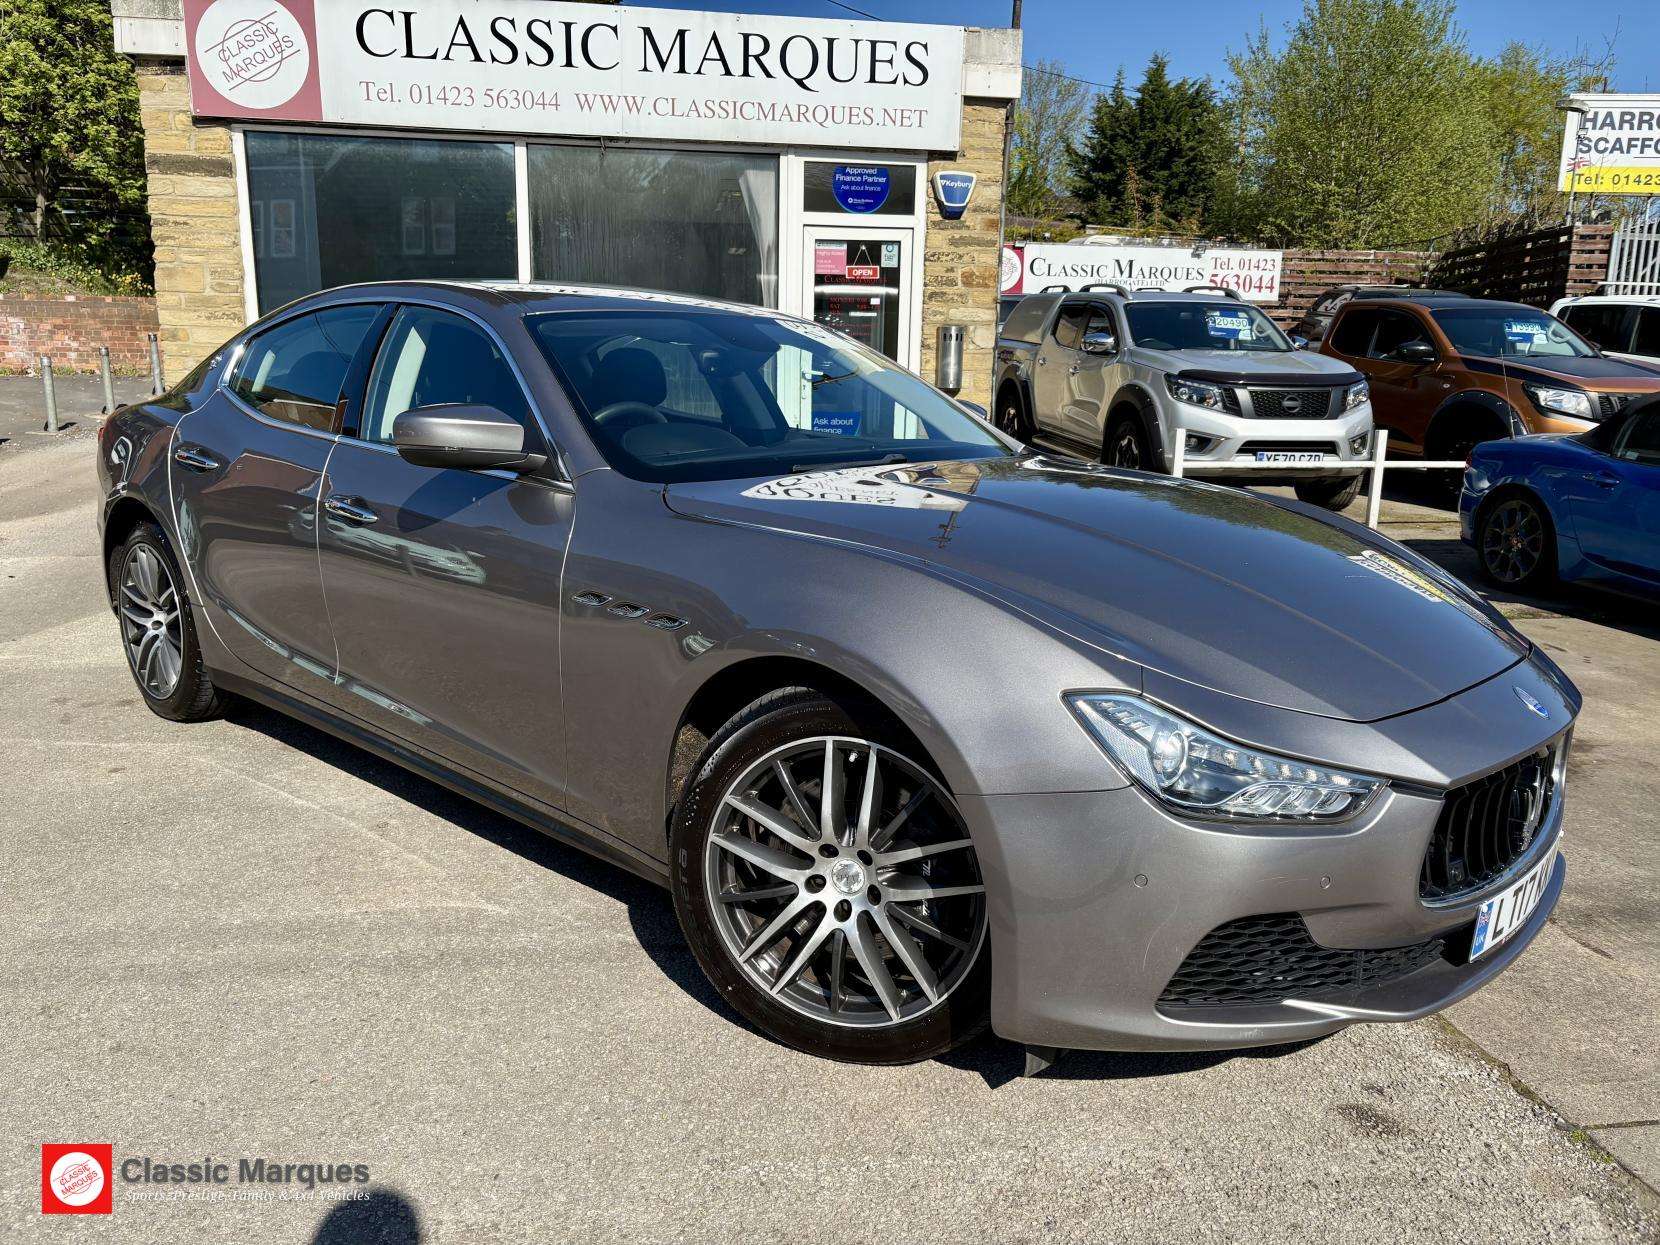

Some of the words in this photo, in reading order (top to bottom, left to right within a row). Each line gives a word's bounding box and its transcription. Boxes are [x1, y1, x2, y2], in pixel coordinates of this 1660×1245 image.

[218, 21, 279, 63] CLASSIC
[355, 8, 620, 71] CLASSIC
[637, 26, 930, 93] MARQUES
[222, 35, 295, 84] MARQUES
[359, 81, 402, 104] Tel.
[409, 83, 475, 107] 01423
[483, 88, 561, 112] 563044
[574, 92, 928, 129] WWW.CLASSICMARQUES.NET
[1582, 110, 1660, 131] HARR
[835, 173, 862, 182] Finance
[862, 174, 887, 183] Partner
[845, 167, 878, 176] Approved
[1576, 173, 1604, 186] Tel:
[945, 179, 973, 189] Keybury
[852, 268, 873, 276] OPEN
[1029, 256, 1108, 279] CLASSIC
[1112, 258, 1205, 283] MARQUES
[1211, 256, 1234, 270] Tel.
[1238, 257, 1276, 272] 01423
[1209, 273, 1275, 293] 563044
[813, 417, 829, 425] Ask
[830, 417, 853, 426] about
